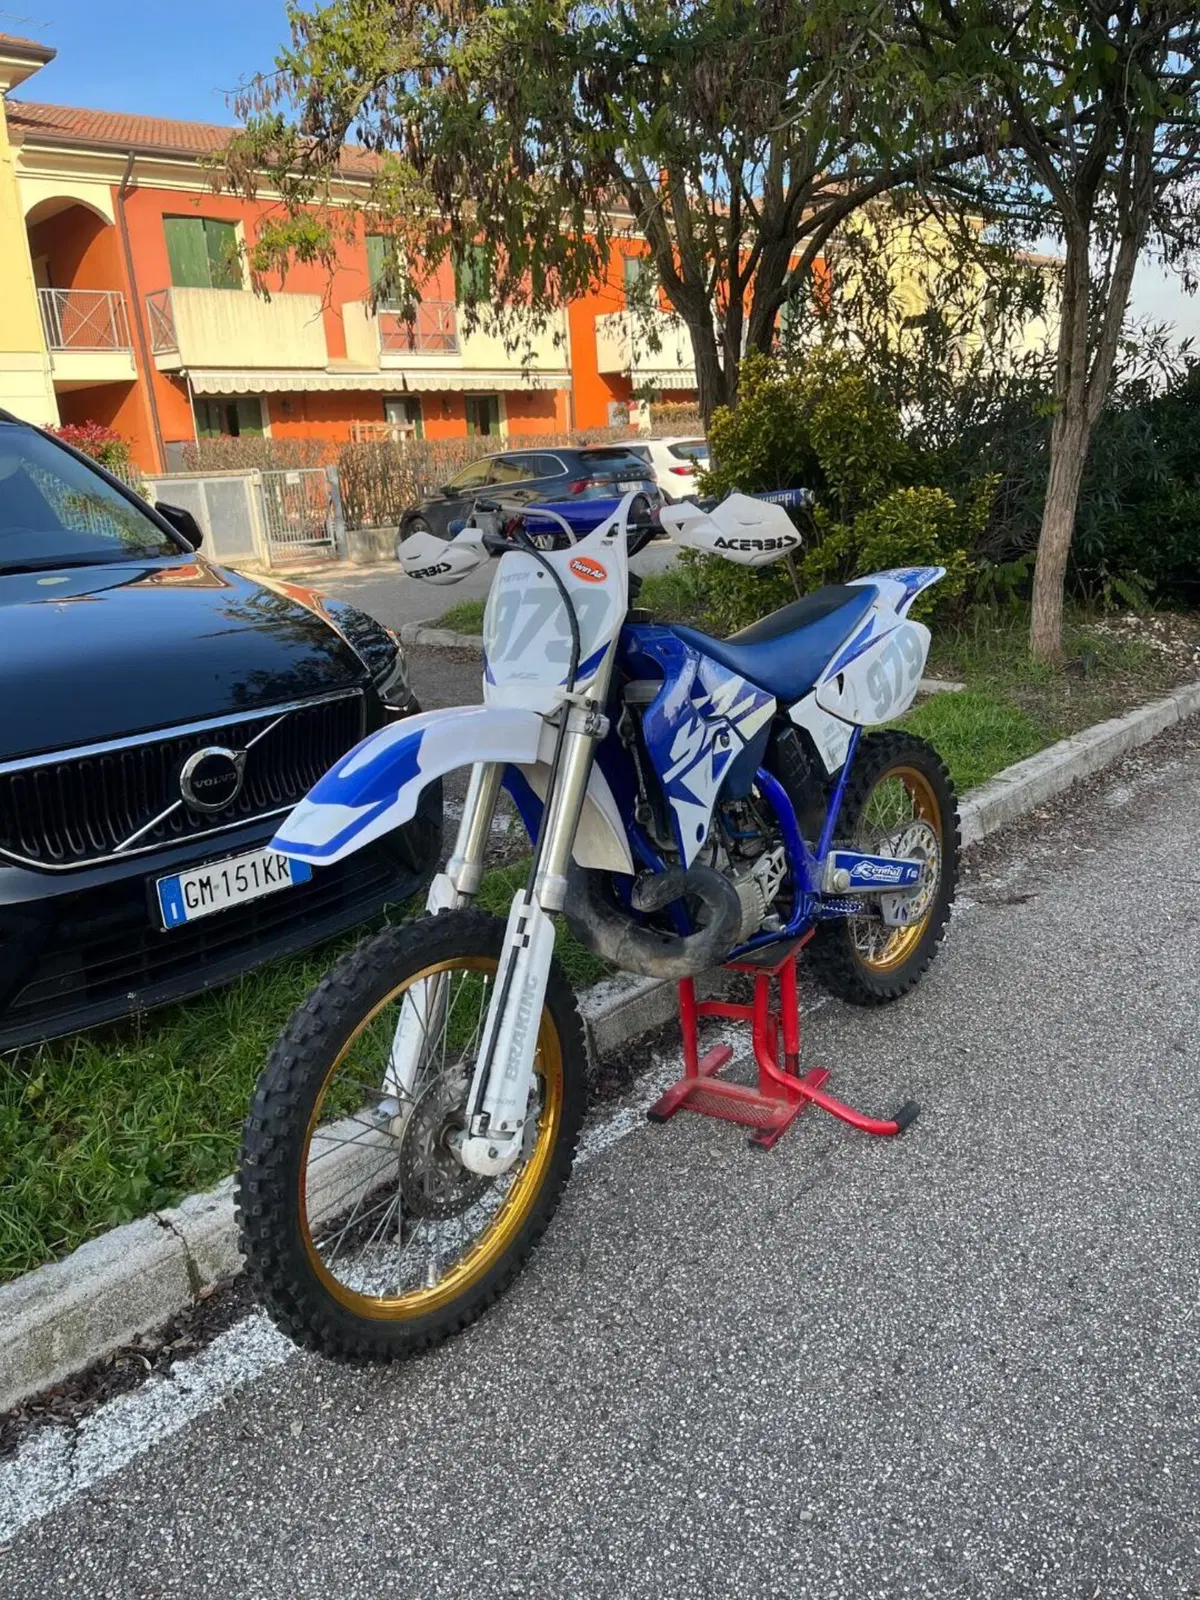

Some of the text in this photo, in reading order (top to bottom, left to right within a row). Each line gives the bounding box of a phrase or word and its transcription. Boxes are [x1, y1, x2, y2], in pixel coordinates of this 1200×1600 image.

[713, 535, 798, 551] ACERBIS
[404, 562, 452, 579] CERBIS
[572, 560, 605, 579] Twin Air
[484, 587, 612, 664] 979
[866, 624, 924, 719] 979
[193, 772, 236, 788] VOLVO
[505, 974, 538, 1082] BRAKING
